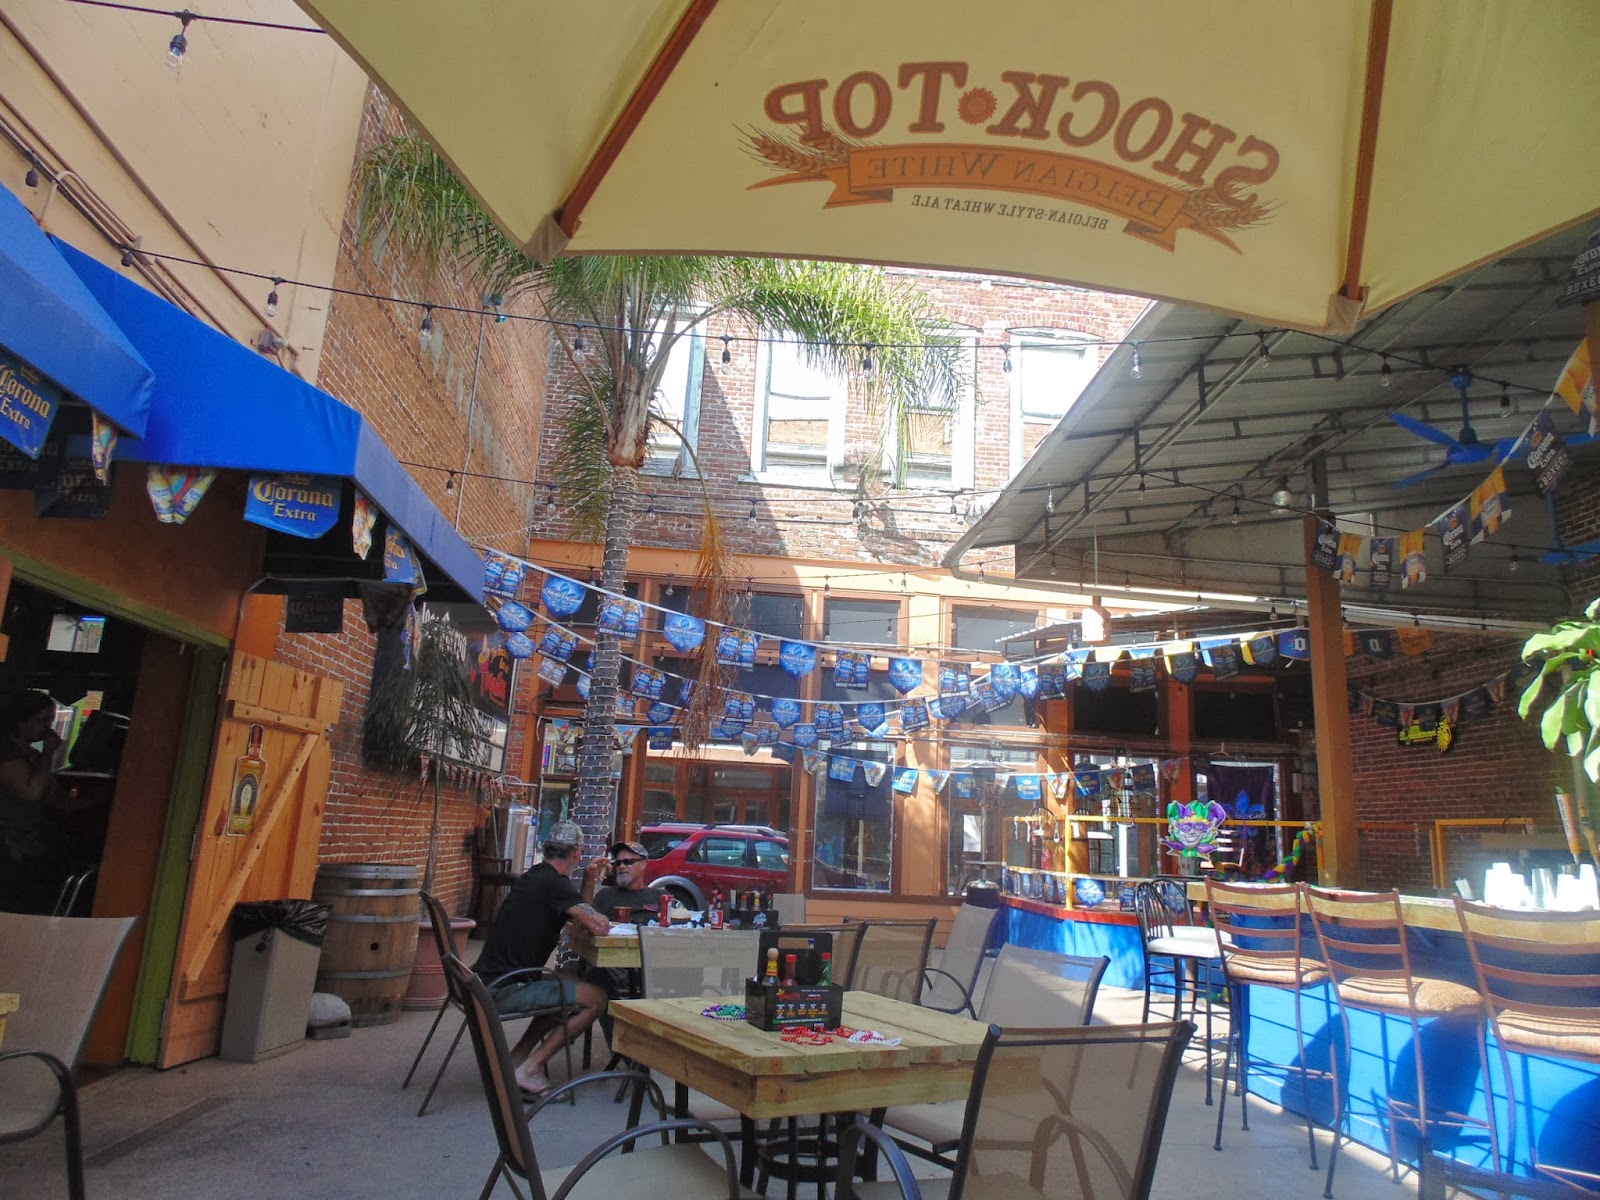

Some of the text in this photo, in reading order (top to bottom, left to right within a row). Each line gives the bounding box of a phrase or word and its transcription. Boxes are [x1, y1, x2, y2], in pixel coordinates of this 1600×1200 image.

[1527, 432, 1554, 469] Corona
[253, 480, 335, 508] Corona
[273, 503, 318, 522] Extra
